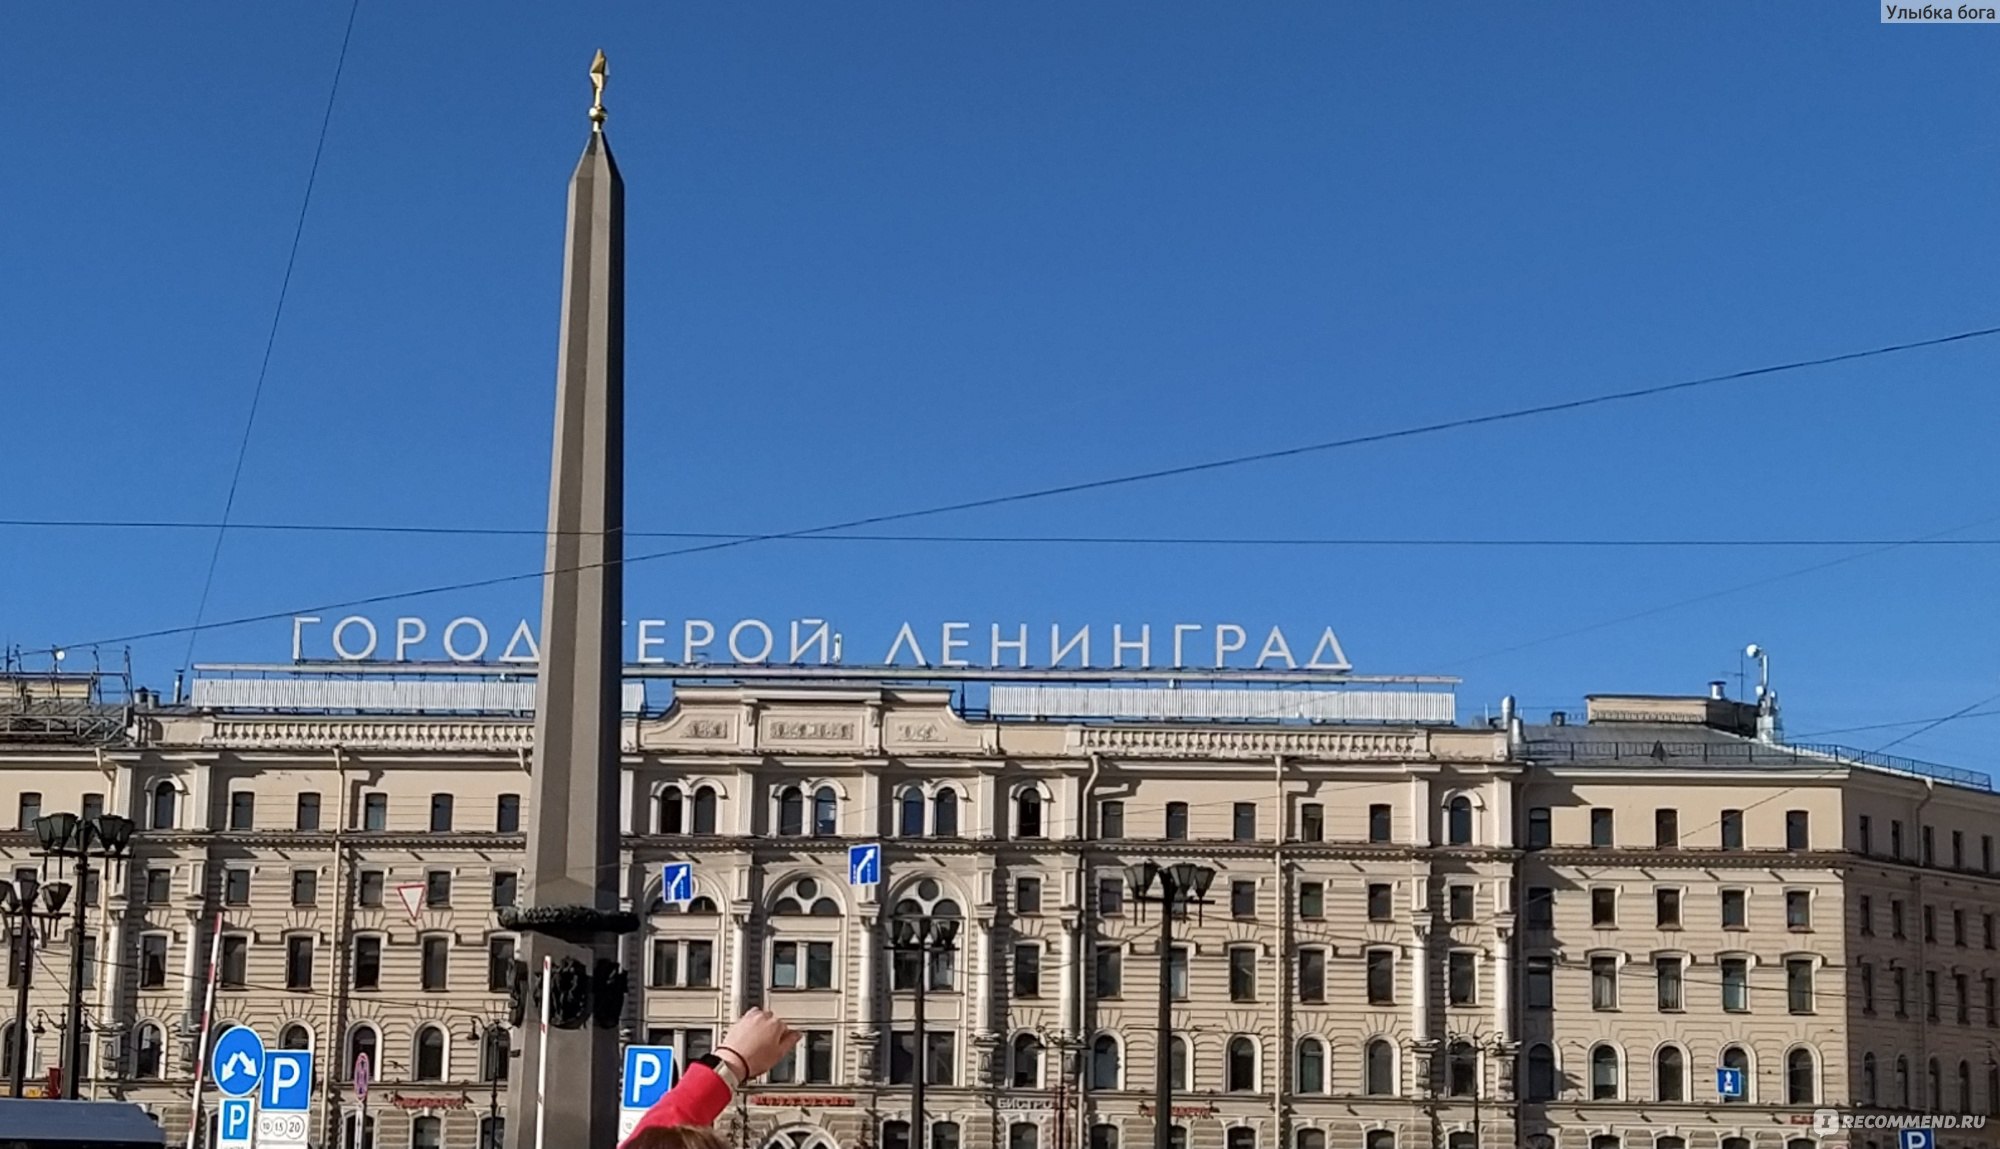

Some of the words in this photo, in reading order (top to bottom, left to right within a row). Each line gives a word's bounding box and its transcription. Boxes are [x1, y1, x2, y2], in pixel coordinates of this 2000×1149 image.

[292, 616, 540, 662] ГОРОД
[622, 618, 829, 664] ЕРОЙ
[884, 621, 1353, 670] ЛЕНИНГРАД
[288, 1121, 300, 1133] 20
